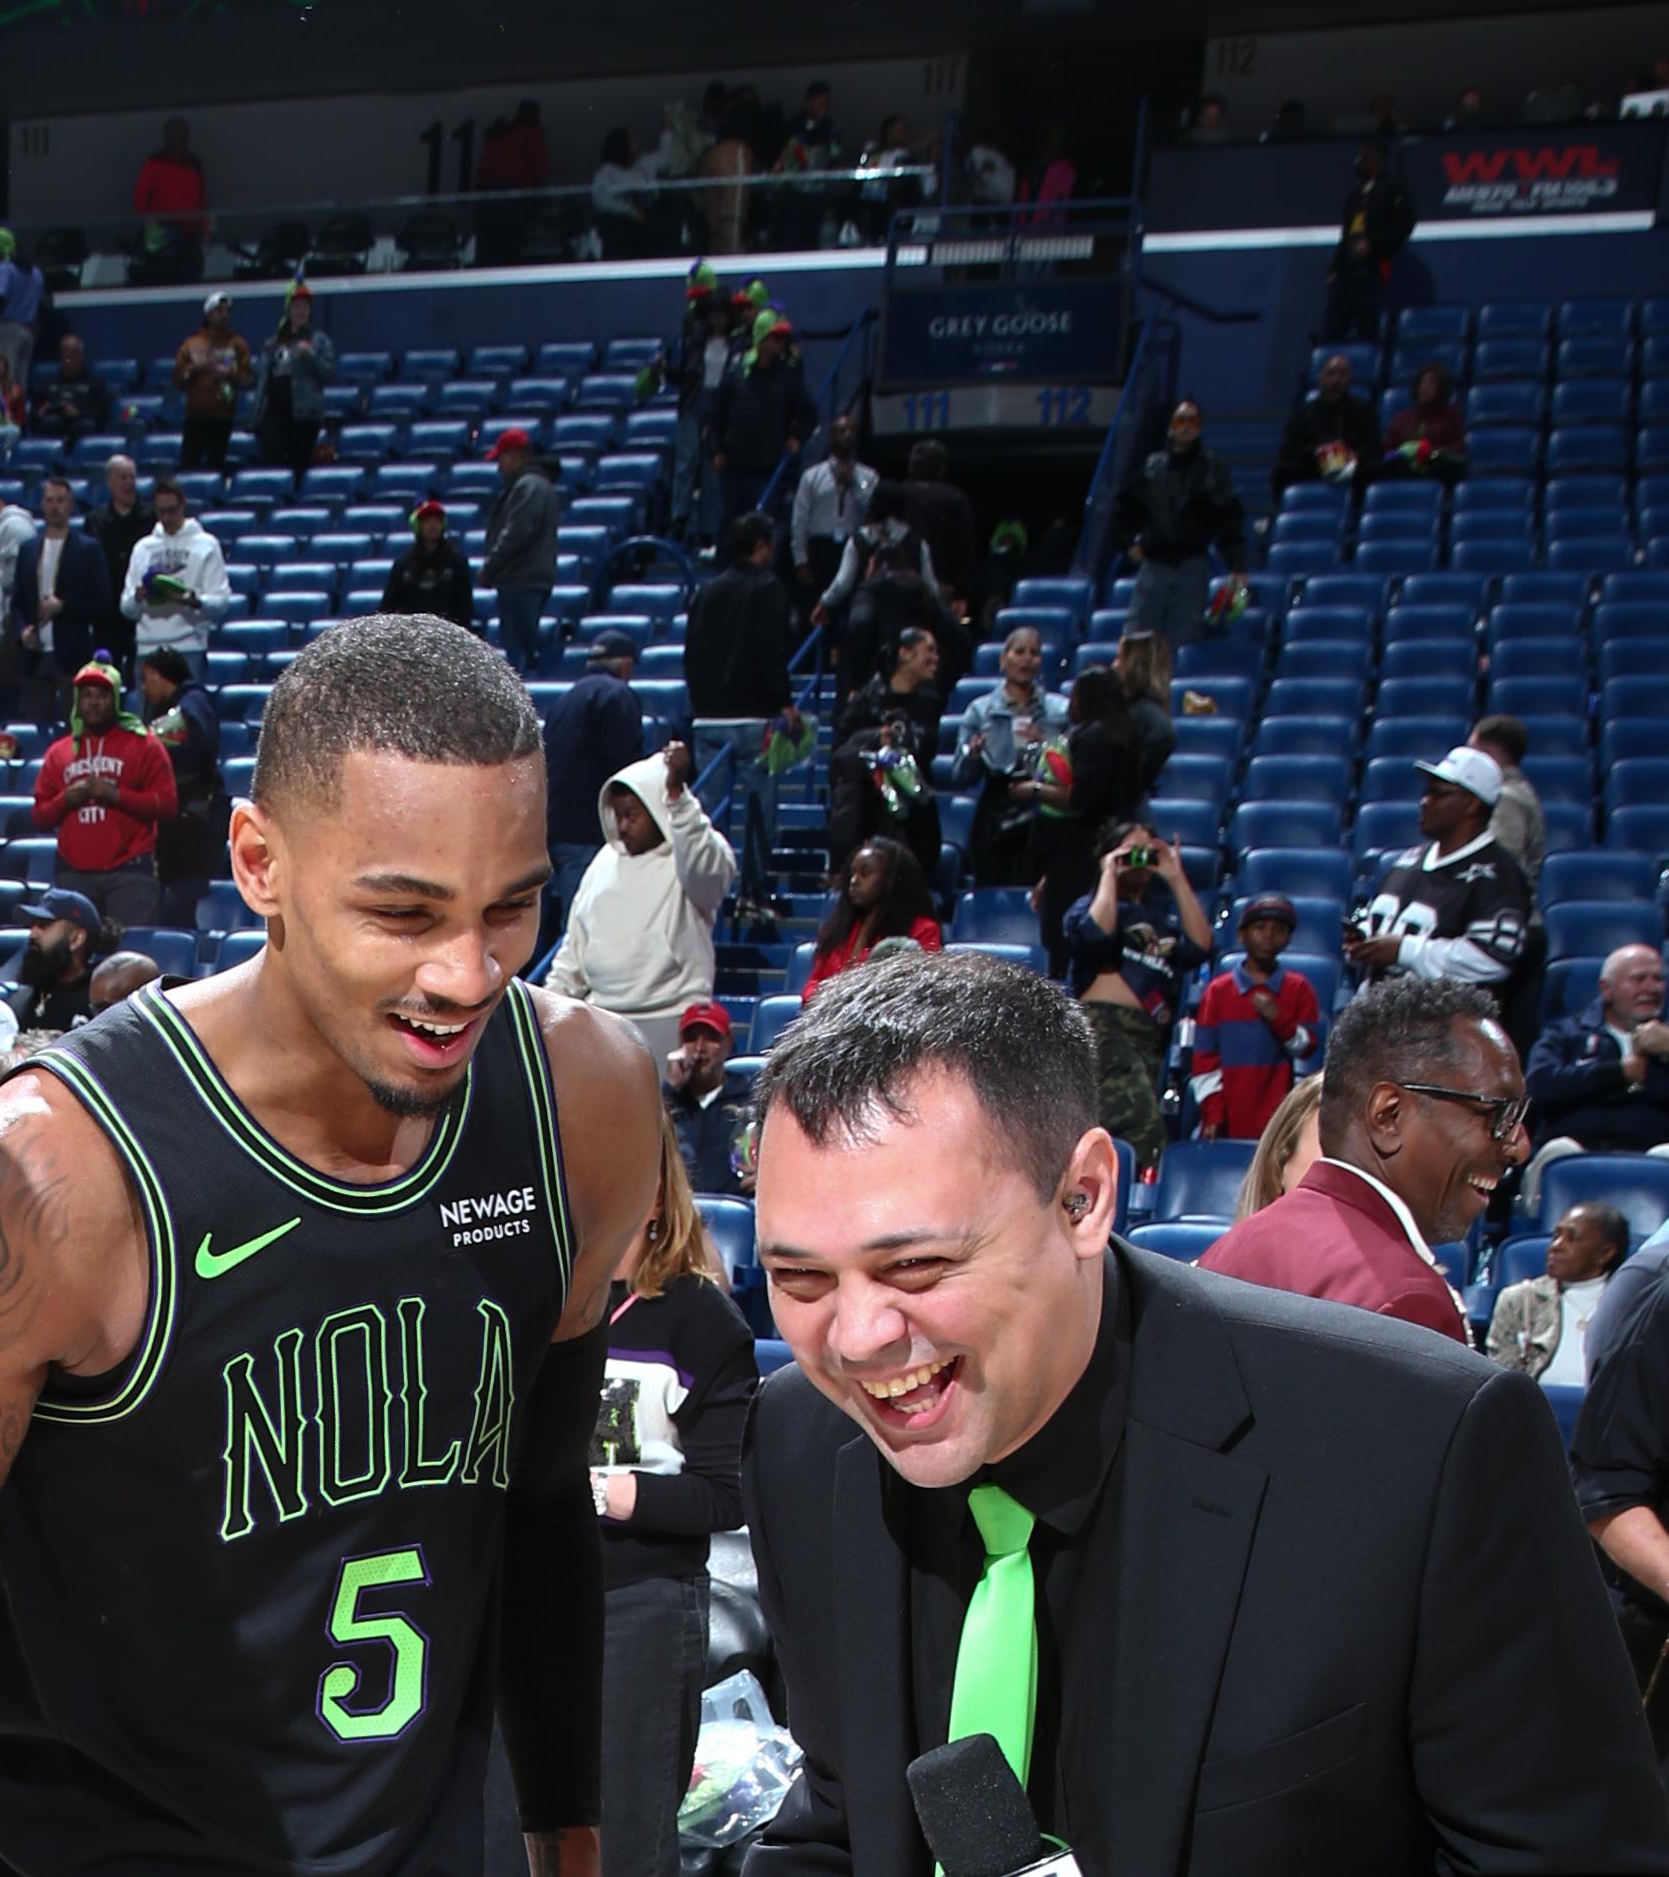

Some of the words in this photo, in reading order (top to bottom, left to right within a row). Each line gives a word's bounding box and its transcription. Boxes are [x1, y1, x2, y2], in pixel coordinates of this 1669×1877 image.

[1216, 40, 1258, 76] 112
[21, 125, 50, 158] 111
[1442, 144, 1619, 183] WWL
[928, 314, 990, 339] GREY
[991, 309, 1074, 336] GOOSE
[904, 390, 951, 431] 111
[1037, 384, 1092, 425] 112
[439, 1186, 537, 1228] NEWAGE
[453, 1219, 530, 1248] PRODUCTS
[219, 1296, 515, 1543] NOLA
[316, 1543, 432, 1744] 5
